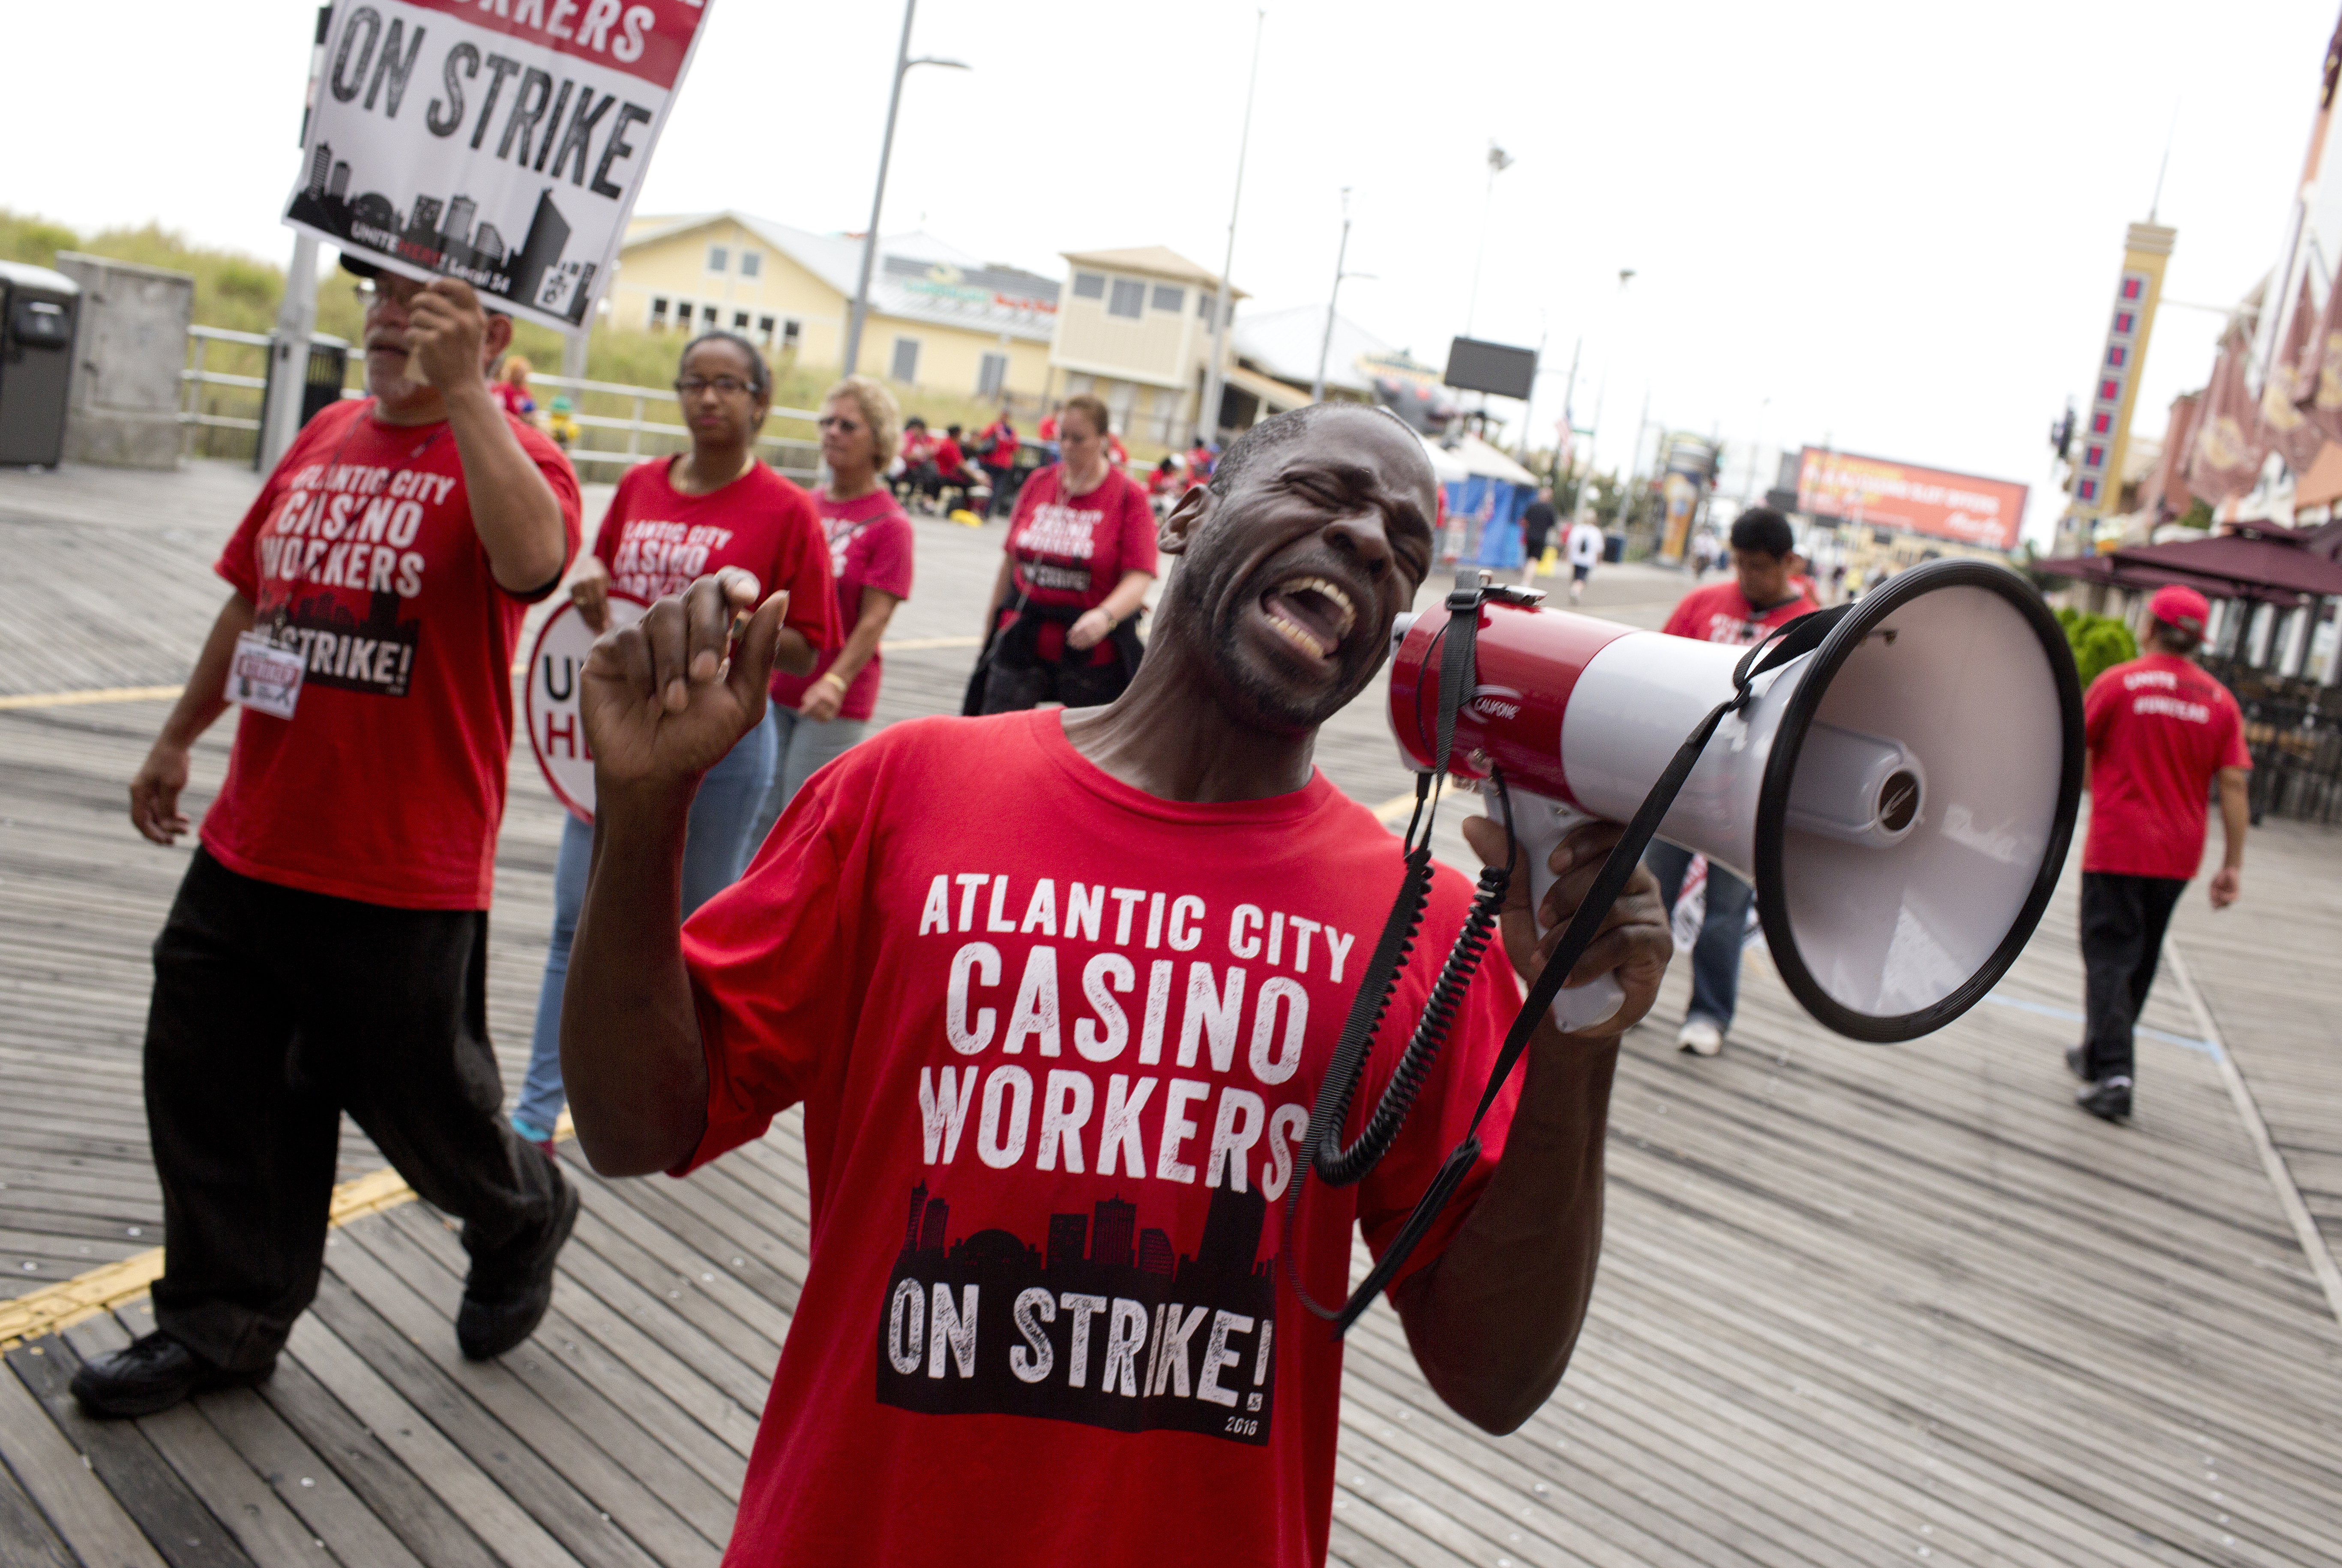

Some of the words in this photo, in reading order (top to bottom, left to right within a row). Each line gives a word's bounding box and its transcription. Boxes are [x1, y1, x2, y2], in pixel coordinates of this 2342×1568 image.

[331, 6, 425, 119] ON
[426, 41, 652, 200] STRIKE
[276, 490, 424, 549] CASINO
[389, 469, 456, 506] CITY
[261, 536, 425, 598] WORKERS
[918, 873, 1206, 952] ATLANTIC
[1228, 903, 1355, 984] CITY
[946, 942, 1309, 1085] CASINO
[918, 1064, 1311, 1203] WORKERS
[888, 1277, 979, 1379] ON
[1009, 1287, 1273, 1412] STRIKE!
